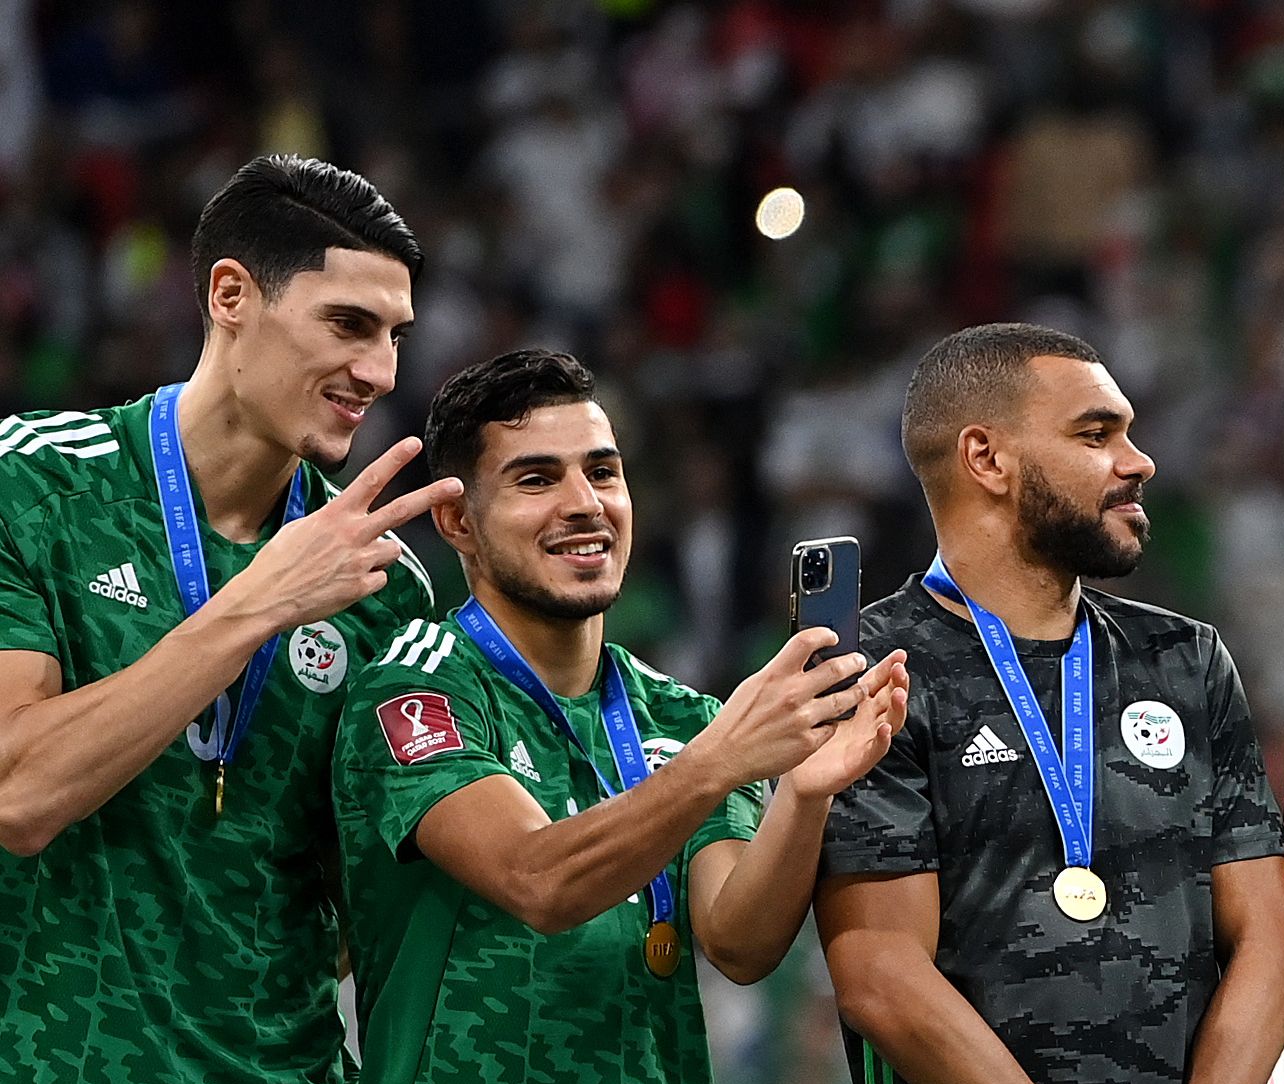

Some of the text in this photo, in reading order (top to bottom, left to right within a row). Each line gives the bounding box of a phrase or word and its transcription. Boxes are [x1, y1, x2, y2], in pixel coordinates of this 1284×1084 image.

[159, 432, 171, 455] FIFA
[166, 469, 179, 493] FIFA
[173, 506, 186, 530] FIFA
[181, 544, 193, 568] FIFA
[89, 581, 148, 608] adidas
[188, 581, 201, 606] FIFA
[466, 613, 484, 633] FIFA
[988, 624, 1005, 648] FIFA
[486, 640, 507, 661] FIFA
[1002, 661, 1020, 684] FIFA
[1072, 657, 1082, 680] FIFA
[1018, 695, 1035, 719] FIFA
[1072, 692, 1083, 715] FIFA
[612, 710, 625, 732] FIFA
[407, 737, 446, 757] QATAR 2021
[415, 734, 433, 745] ARAB
[1033, 730, 1049, 754] FIFA
[1073, 728, 1083, 751] FIFA
[622, 743, 637, 765] FIFA
[961, 748, 1018, 767] adidas
[1048, 767, 1062, 791] FIFA
[1074, 765, 1083, 789] FIFA
[1060, 803, 1075, 828] FIFA
[652, 942, 675, 957] FIFA
